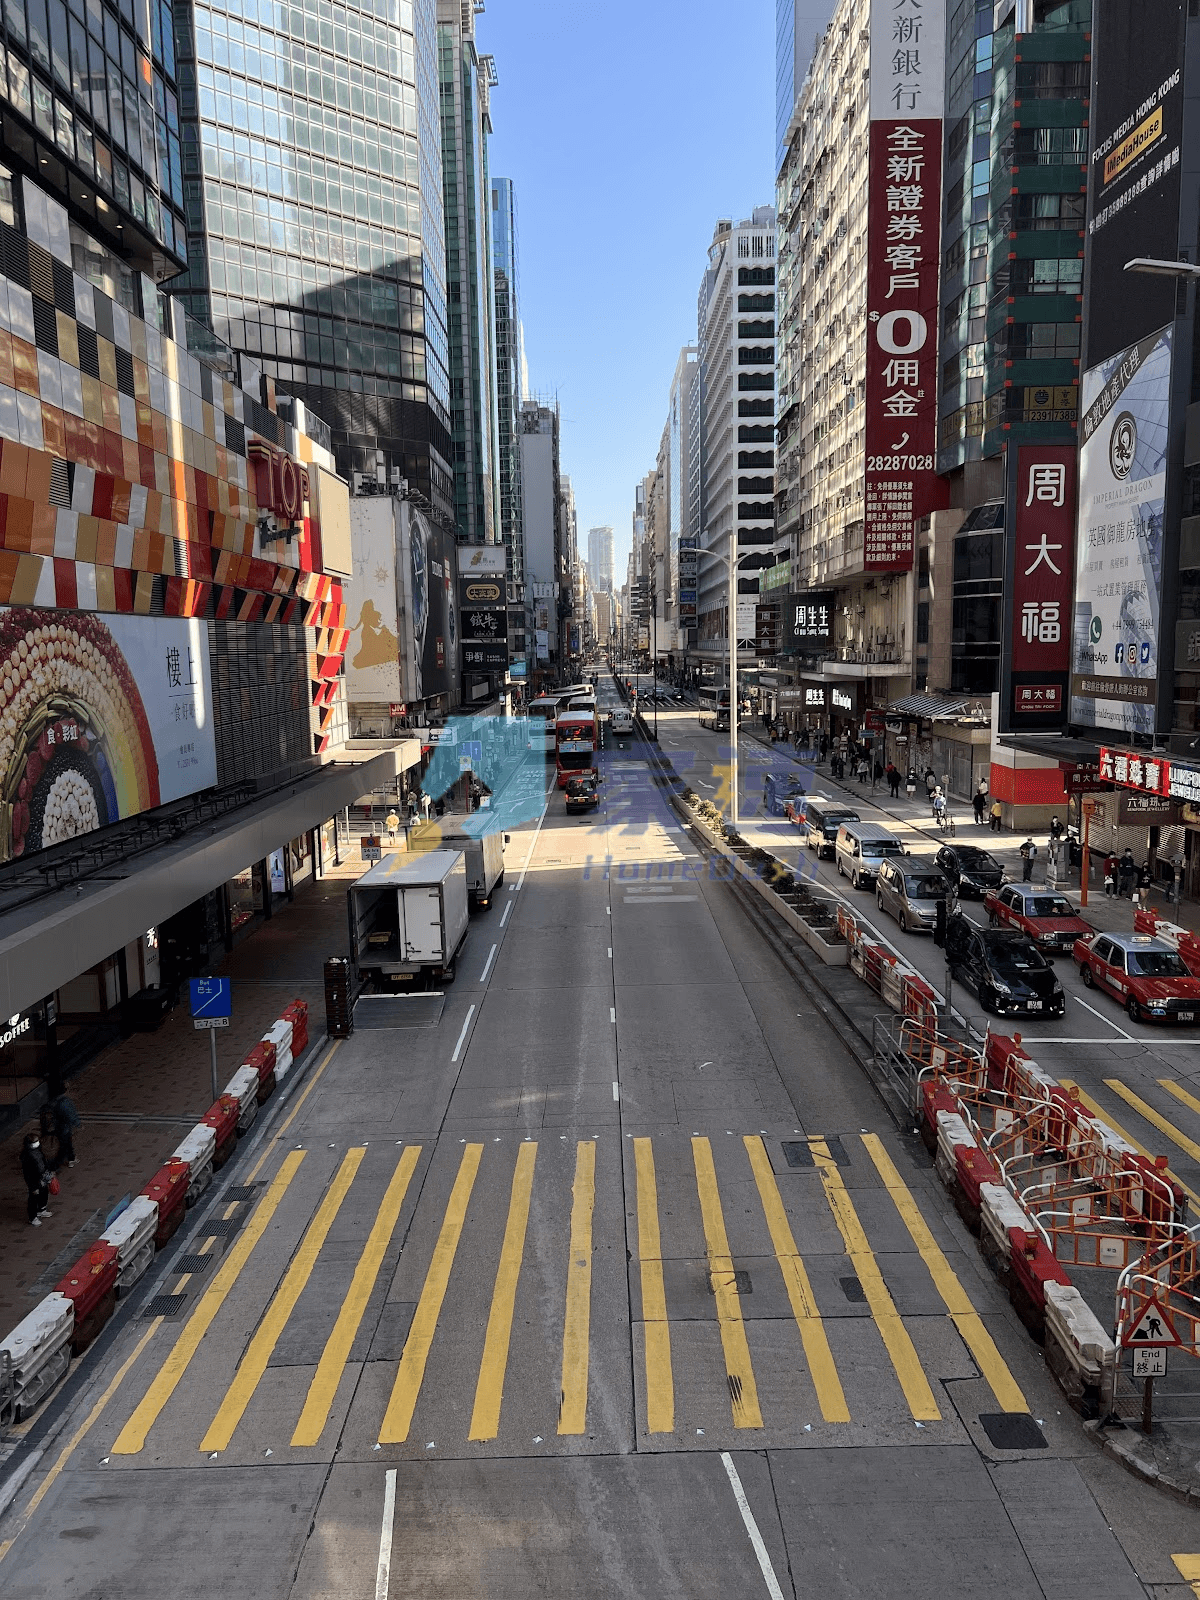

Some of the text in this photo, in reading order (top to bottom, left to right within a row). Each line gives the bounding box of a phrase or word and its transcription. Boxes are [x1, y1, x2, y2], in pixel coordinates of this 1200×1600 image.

[1092, 68, 1180, 164] FOCUS MEDIA HONG KONG
[884, 126, 926, 299] 全新證券客戶
[881, 359, 921, 417] 佣金
[1084, 345, 1142, 439] 倫敦地產代理
[1031, 410, 1076, 421] 2391 7389
[867, 455, 933, 471] 28287028
[248, 440, 310, 520] TOP
[1093, 479, 1153, 505] IMPERIAL DRAGON
[1022, 463, 1065, 644] 周大福
[795, 605, 829, 627] 周生生
[166, 646, 199, 688] 樓上
[465, 652, 483, 662] 爭鮮
[1081, 652, 1108, 665] WhatsApp
[1022, 689, 1056, 700] 周大福
[392, 704, 405, 712] JM
[1100, 752, 1159, 791] 六福珠寶
[198, 986, 212, 994] 巴士
[1142, 1350, 1160, 1358] End
[1136, 1361, 1163, 1374] 終止
